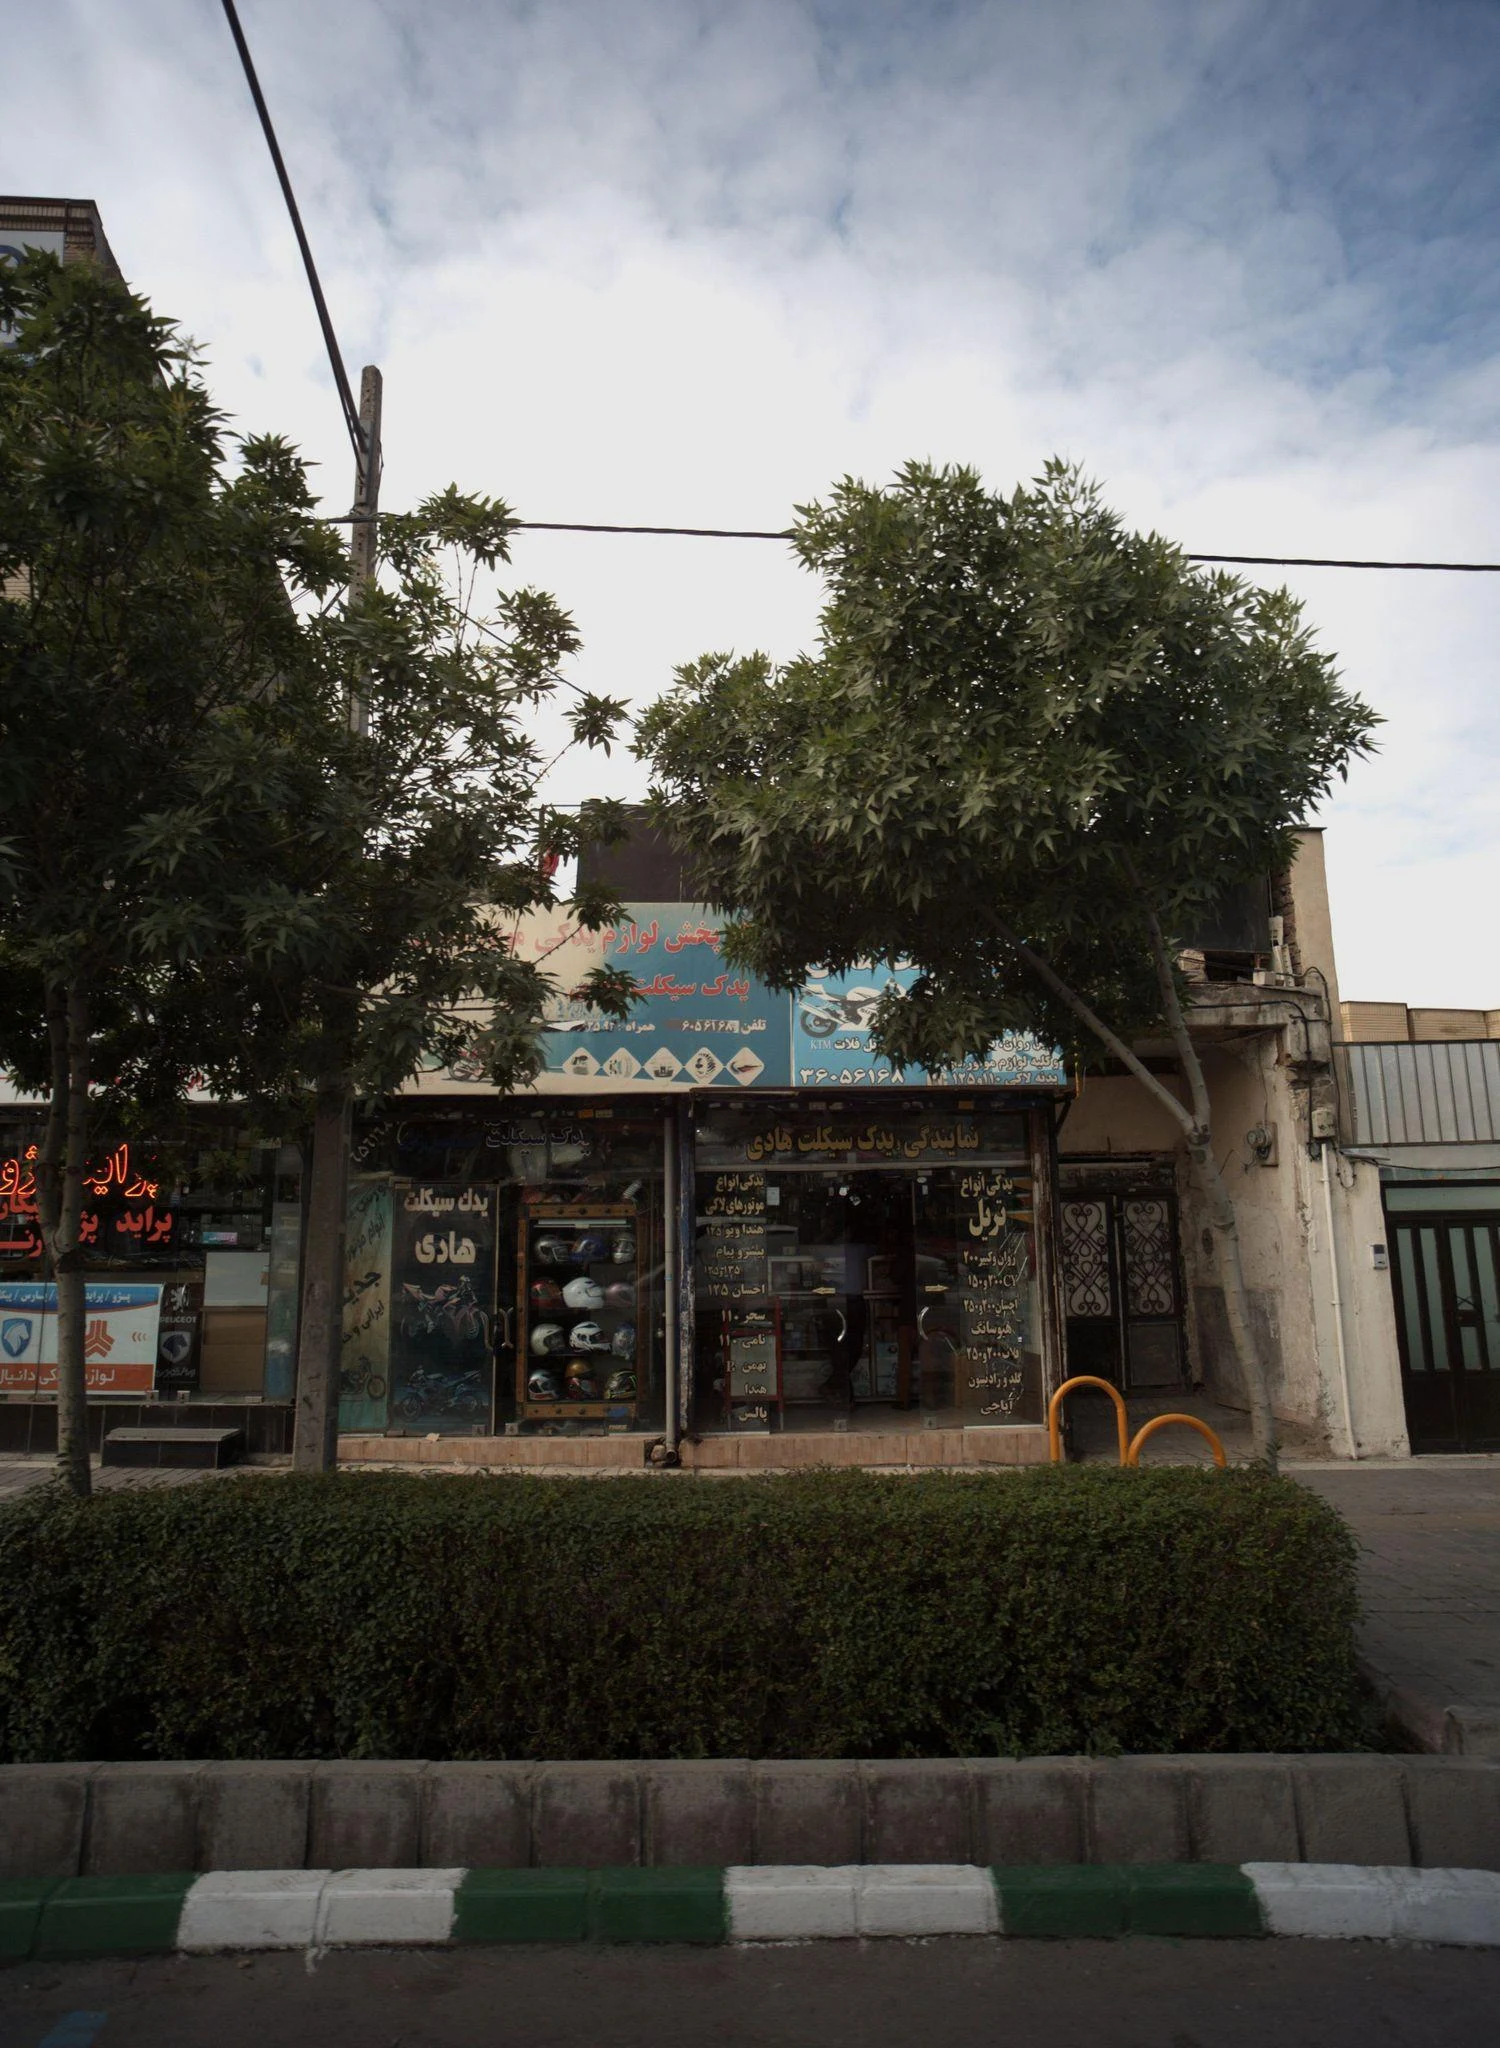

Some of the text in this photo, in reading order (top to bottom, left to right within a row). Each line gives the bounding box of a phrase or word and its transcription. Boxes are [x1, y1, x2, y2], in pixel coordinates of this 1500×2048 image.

[602, 920, 659, 954] لوازم
[666, 921, 721, 953] پخش
[631, 974, 696, 999] سیکلت
[702, 974, 749, 998] یدک
[740, 1019, 767, 1035] تلفن
[810, 1040, 831, 1050] KTM
[799, 1067, 905, 1085] ۳۶۰۵۶۱۶۸
[746, 1123, 980, 1161] نمایندگی یدک سیکلت هادی
[961, 1171, 1014, 1197] یدکی انواع
[404, 1187, 455, 1217] سیکلت
[78, 1210, 99, 1244] پژ
[115, 1205, 174, 1244] پراید
[968, 1198, 1007, 1242] تریل
[415, 1230, 477, 1264] هادی
[732, 1283, 766, 1298] احسان
[86, 1368, 115, 1385] لواز
